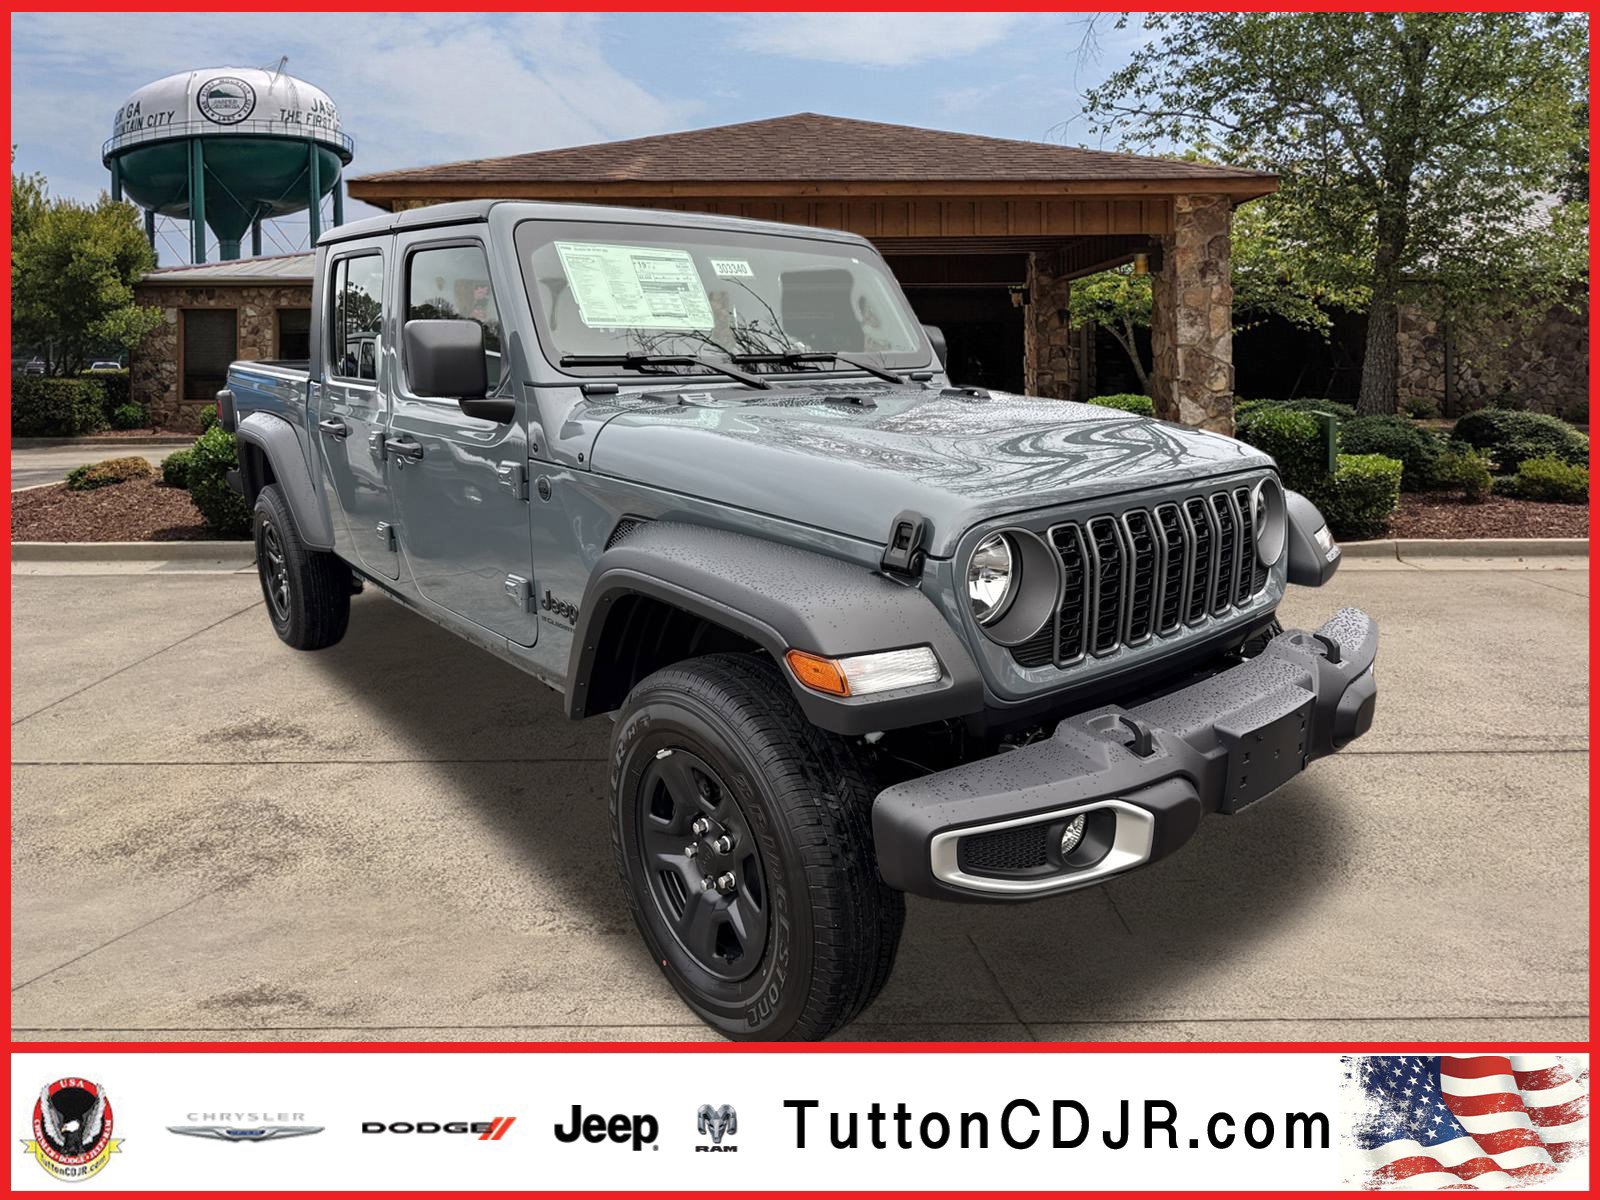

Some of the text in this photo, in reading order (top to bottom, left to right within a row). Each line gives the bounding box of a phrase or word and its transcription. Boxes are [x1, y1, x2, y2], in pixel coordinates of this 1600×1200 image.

[126, 100, 141, 119] GA
[147, 110, 176, 128] CITY
[280, 108, 302, 124] THE
[306, 112, 332, 129] FIRST
[716, 263, 748, 274] 303340
[542, 590, 579, 626] Jeep
